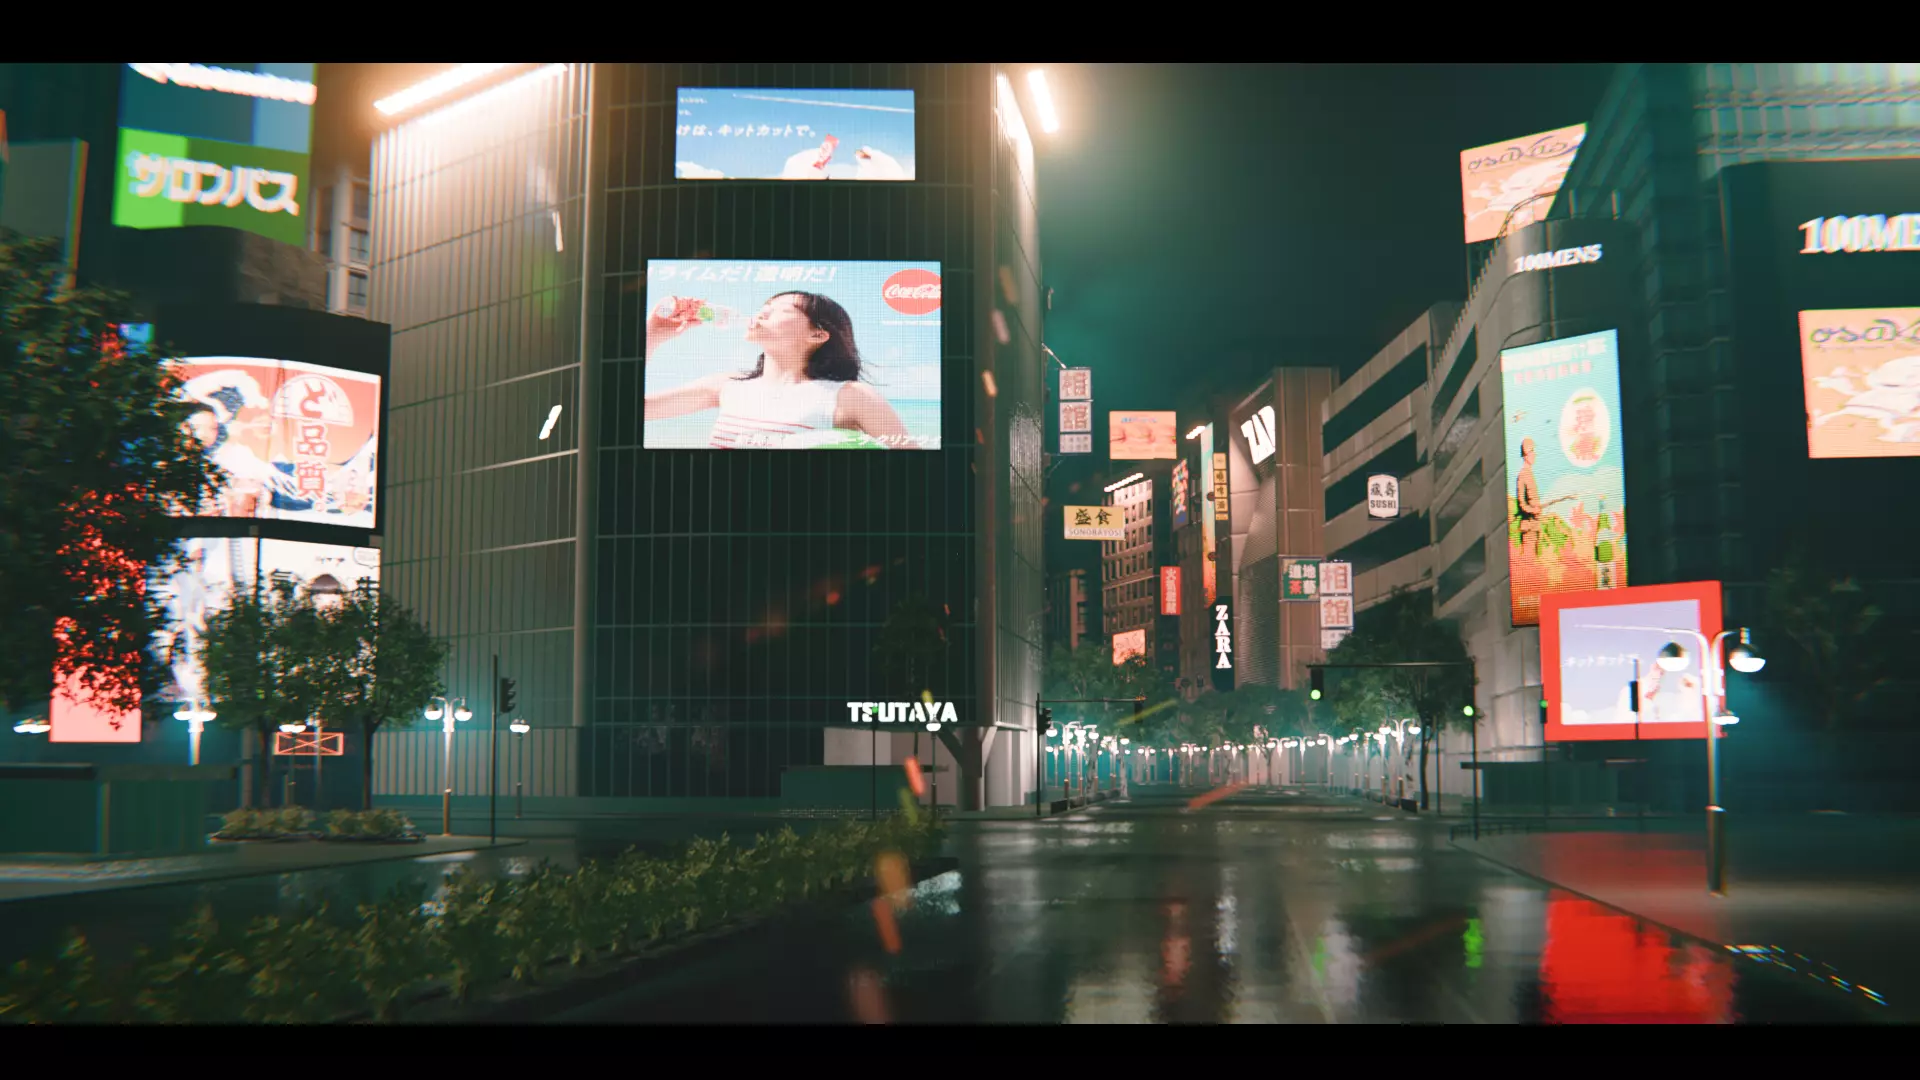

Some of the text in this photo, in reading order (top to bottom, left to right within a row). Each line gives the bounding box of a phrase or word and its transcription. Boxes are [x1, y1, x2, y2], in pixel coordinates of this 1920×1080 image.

[126, 151, 300, 217] サロンパス
[1515, 244, 1602, 272] 100MENS
[1370, 500, 1397, 508] SUSHI
[1215, 604, 1232, 669] ZARA
[847, 701, 958, 723] TSUTAYA
